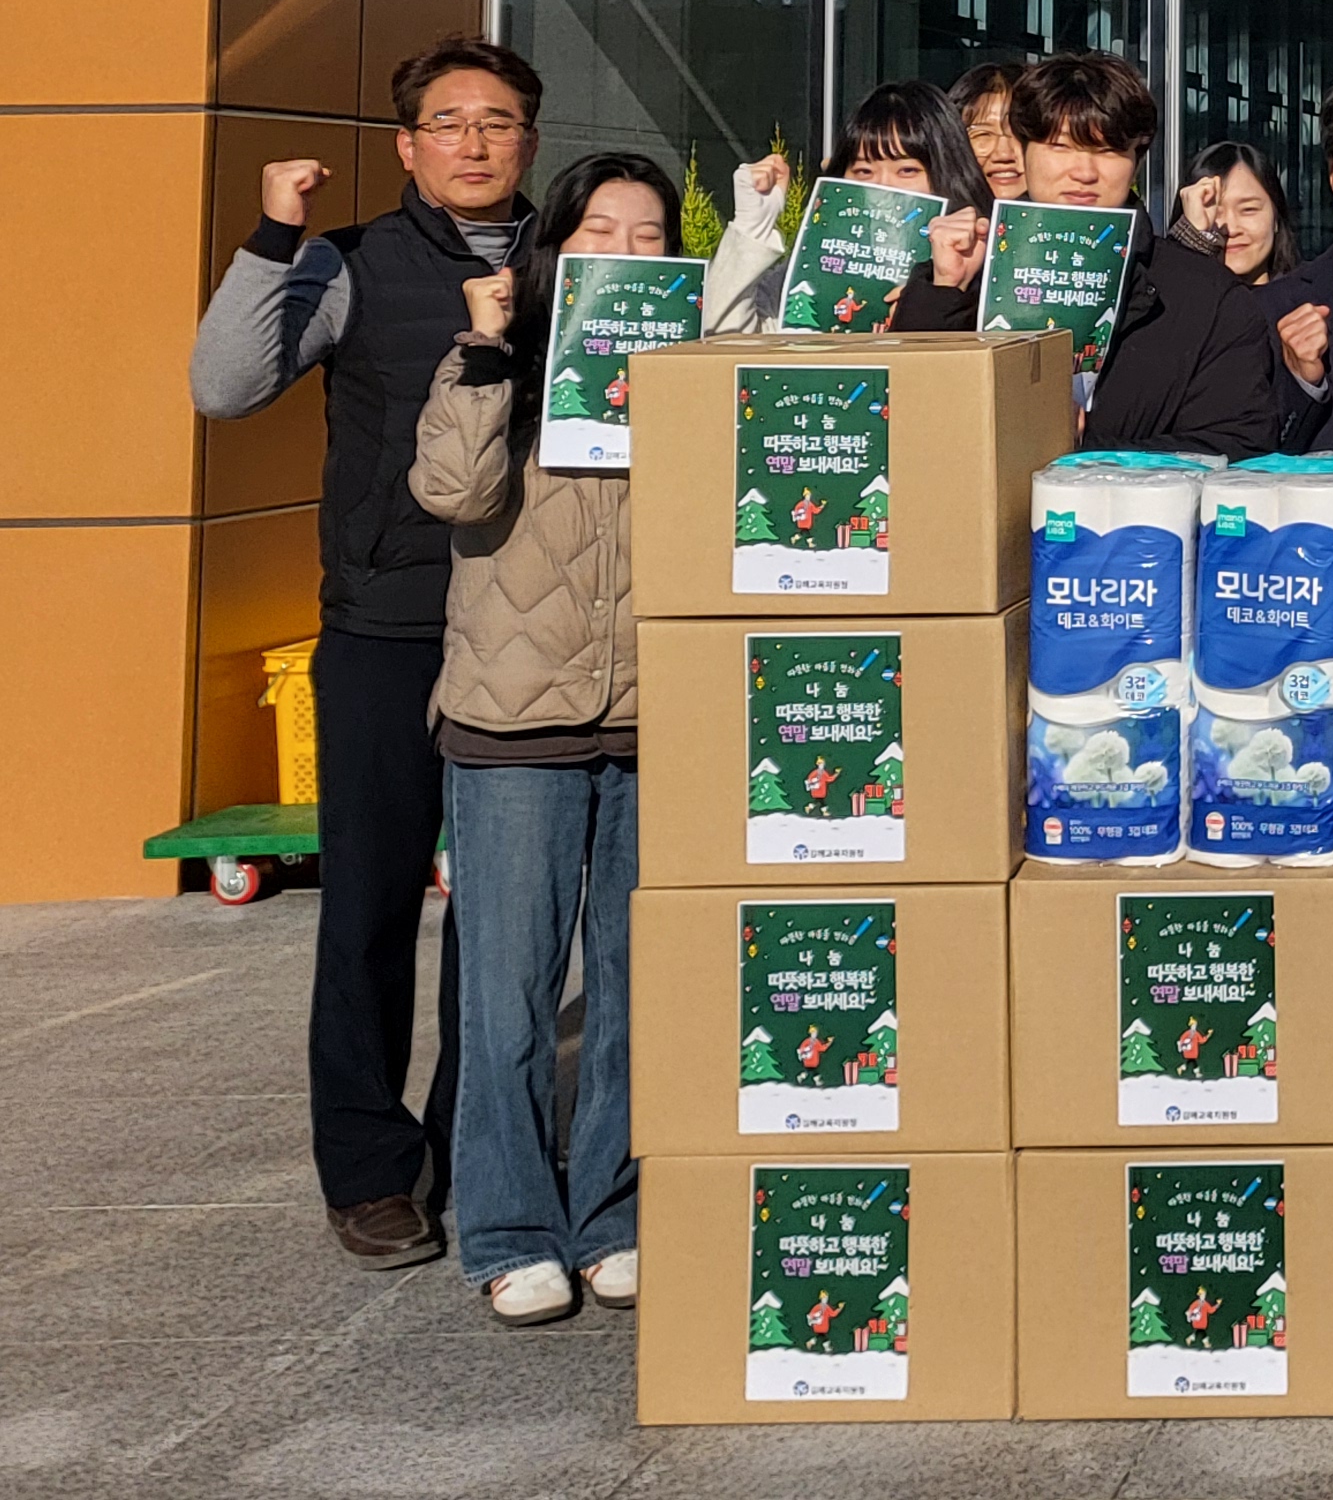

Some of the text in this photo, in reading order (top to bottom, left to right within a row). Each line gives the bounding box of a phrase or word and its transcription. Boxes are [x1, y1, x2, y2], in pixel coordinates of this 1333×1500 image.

[821, 238, 912, 267] 따뜻하고 행복한
[820, 255, 845, 274] 연말
[1013, 268, 1109, 289] 따뜻하고 행복한
[1014, 286, 1042, 304] 연말
[582, 319, 685, 339] 따뜻하고 행복한
[763, 435, 868, 454] 따뜻하고 행복한
[766, 456, 795, 474] 연말
[1046, 576, 1157, 607] 모나리자
[1215, 570, 1323, 606] 모나리자
[1058, 612, 1145, 631] 데코&화이트
[1226, 606, 1311, 629] 데코&화이트
[1125, 675, 1145, 690] 3겹
[1289, 674, 1310, 689] 3겹
[775, 702, 881, 723] 따뜻하고 행복한
[778, 725, 808, 744] 연말
[767, 970, 875, 991] 따뜻하고 행복한
[1147, 962, 1254, 983] 따뜻하고 행복한
[770, 994, 801, 1012] 연말
[1150, 986, 1181, 1004] 연말
[779, 1235, 887, 1255] 따뜻하고 행복한
[1155, 1232, 1263, 1253] 따뜻하고 행복한
[781, 1258, 812, 1277] 연말
[1159, 1255, 1189, 1274] 연말
